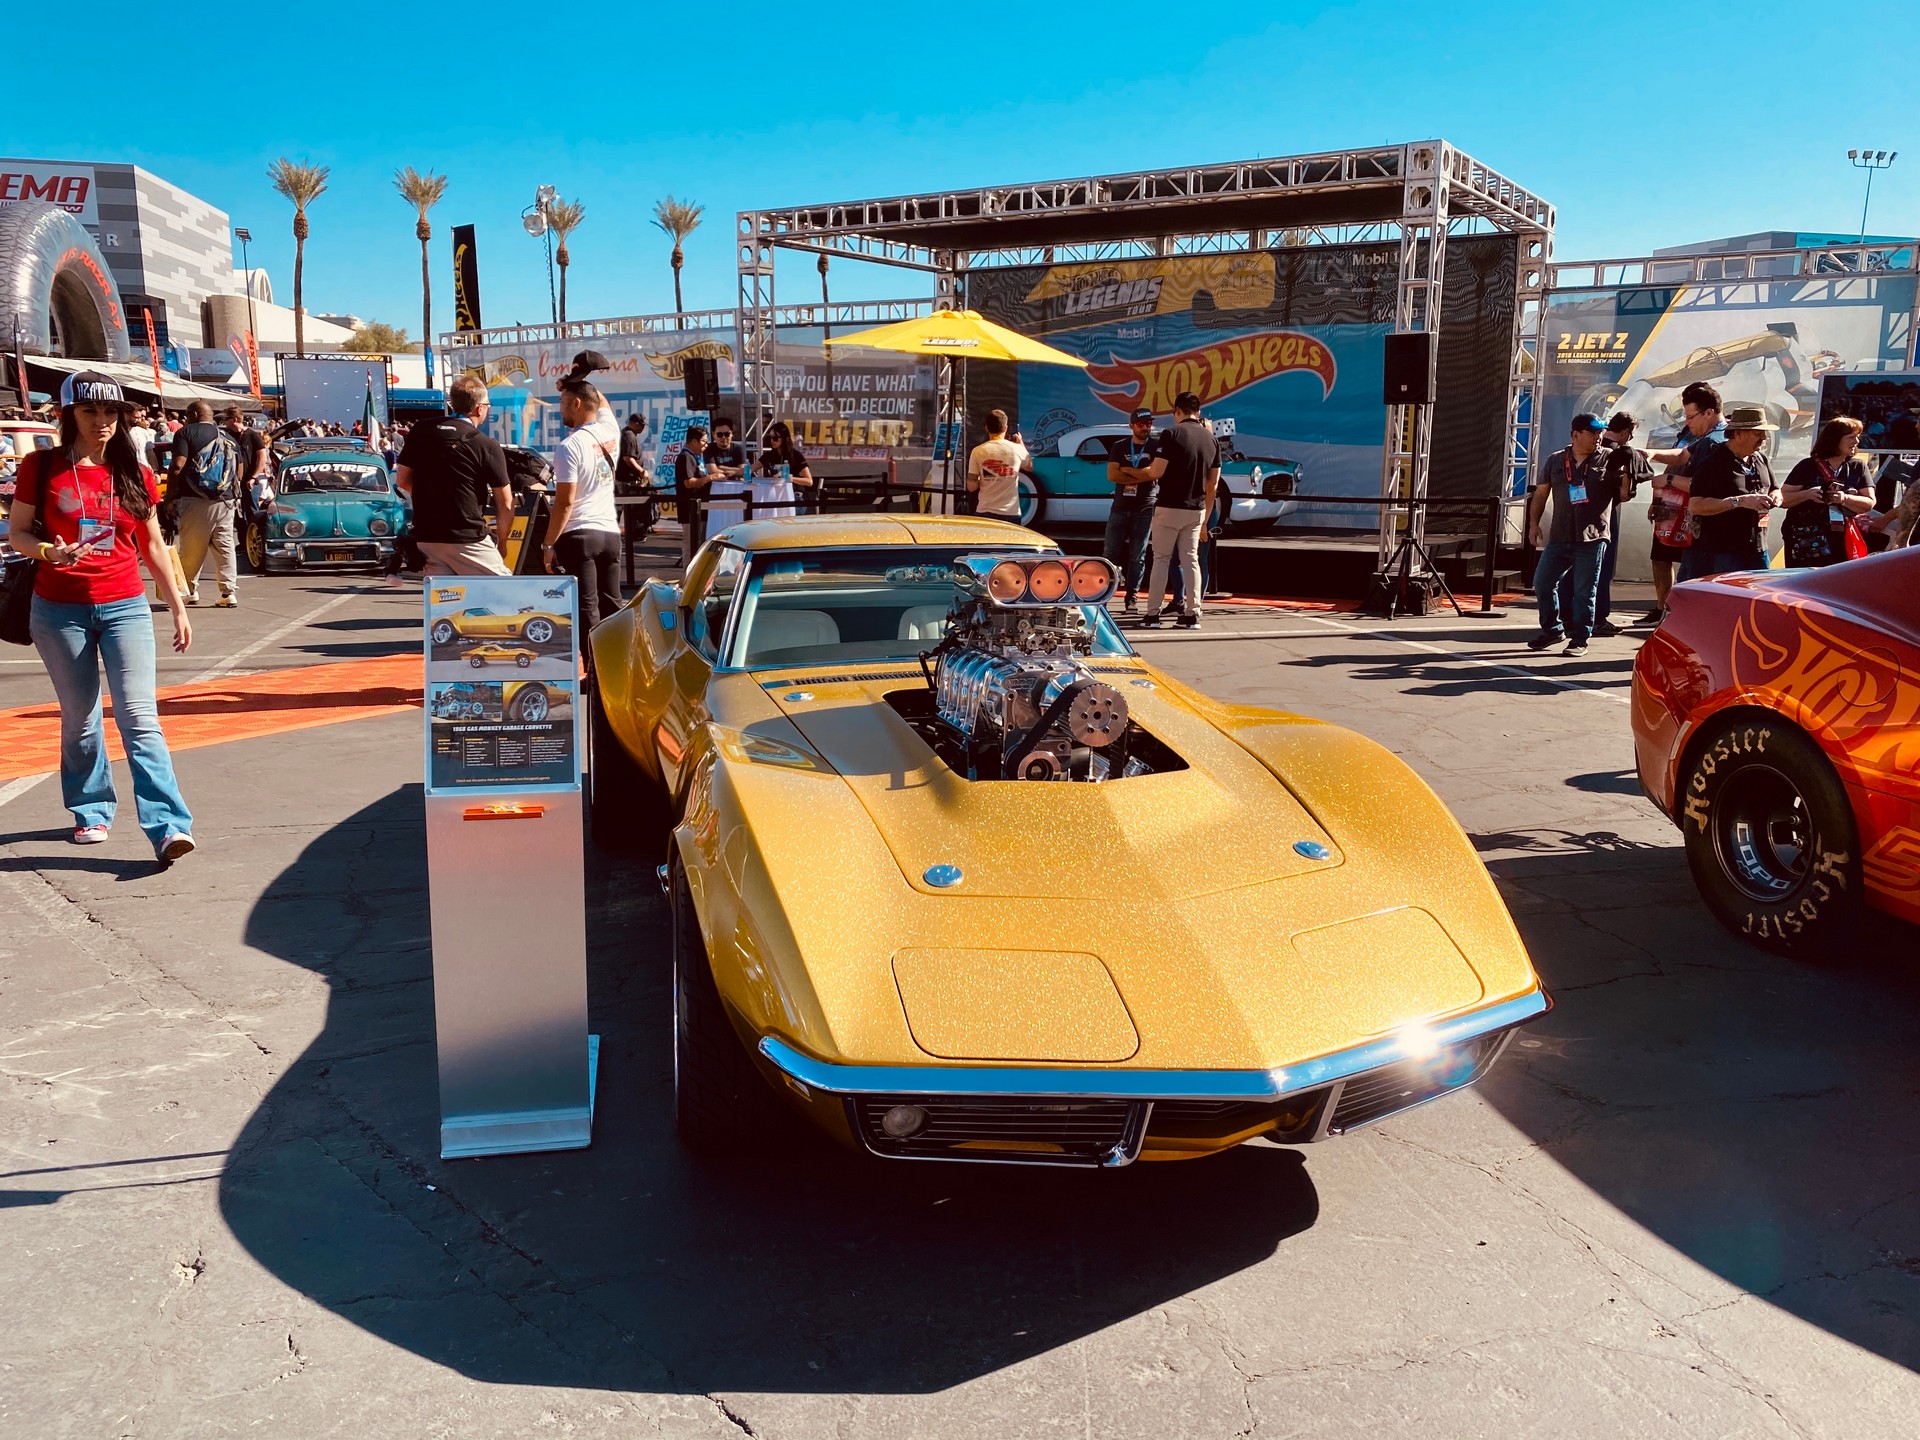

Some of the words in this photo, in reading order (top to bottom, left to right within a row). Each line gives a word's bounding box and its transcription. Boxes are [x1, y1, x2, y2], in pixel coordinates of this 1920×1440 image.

[1352, 252, 1389, 266] Mobil
[1064, 275, 1164, 315] LEGENDS
[1557, 333, 1571, 350] 2
[1573, 333, 1612, 350] JET
[799, 374, 827, 392] YOU
[831, 375, 871, 392] HAVE
[875, 375, 917, 392] WHAT
[791, 397, 834, 414] TAKES
[837, 397, 855, 414] TO
[859, 397, 916, 415] BECOME
[804, 418, 914, 447] LEGEND?
[853, 447, 890, 459] SEMA
[290, 464, 331, 474] TOYO
[332, 463, 378, 474] TIRES
[1683, 727, 1771, 835] Hoosier
[1736, 822, 1792, 890] COPO
